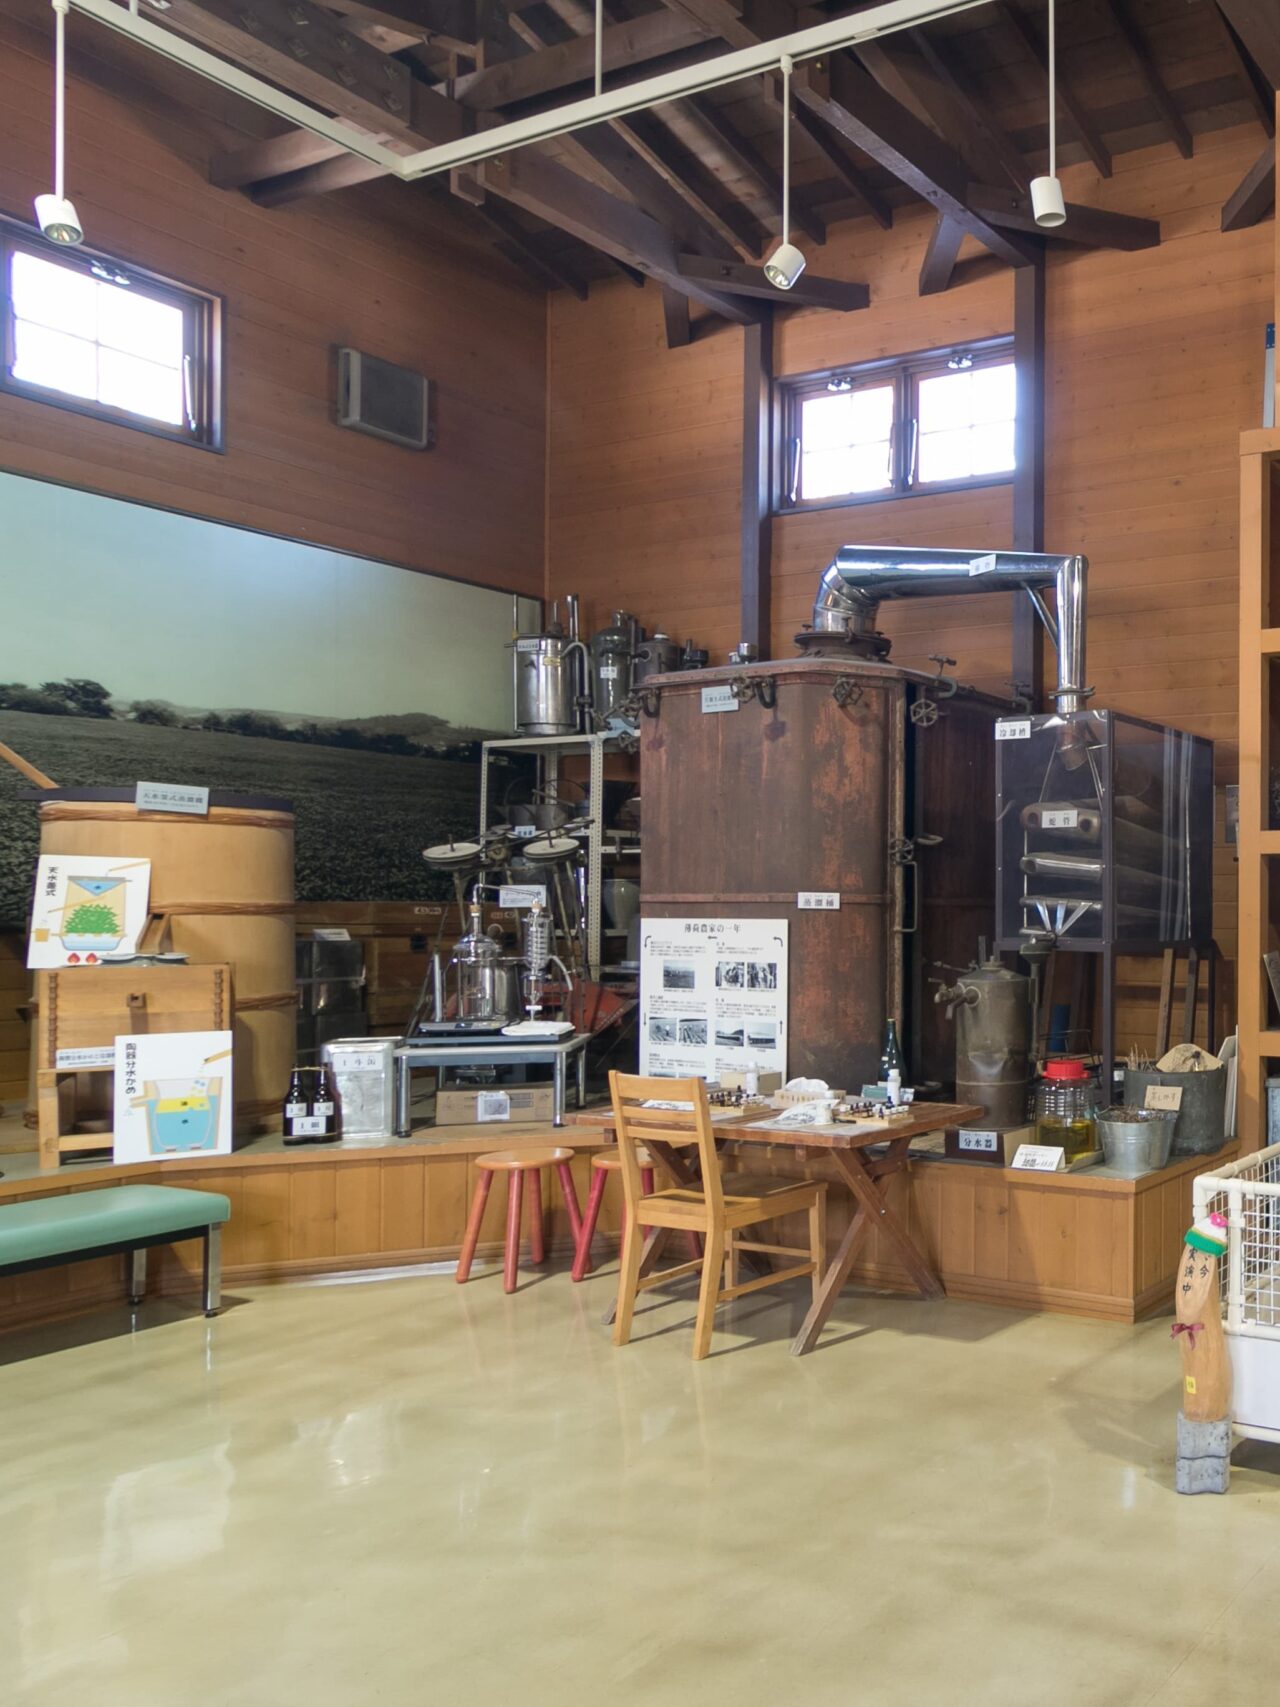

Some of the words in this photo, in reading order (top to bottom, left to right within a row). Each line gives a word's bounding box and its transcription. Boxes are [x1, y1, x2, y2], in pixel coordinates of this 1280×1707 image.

[684, 923, 741, 934] 薄荷農家の一年
[125, 1043, 137, 1095] 陶器分水かめ
[963, 1137, 993, 1149] 分水器
